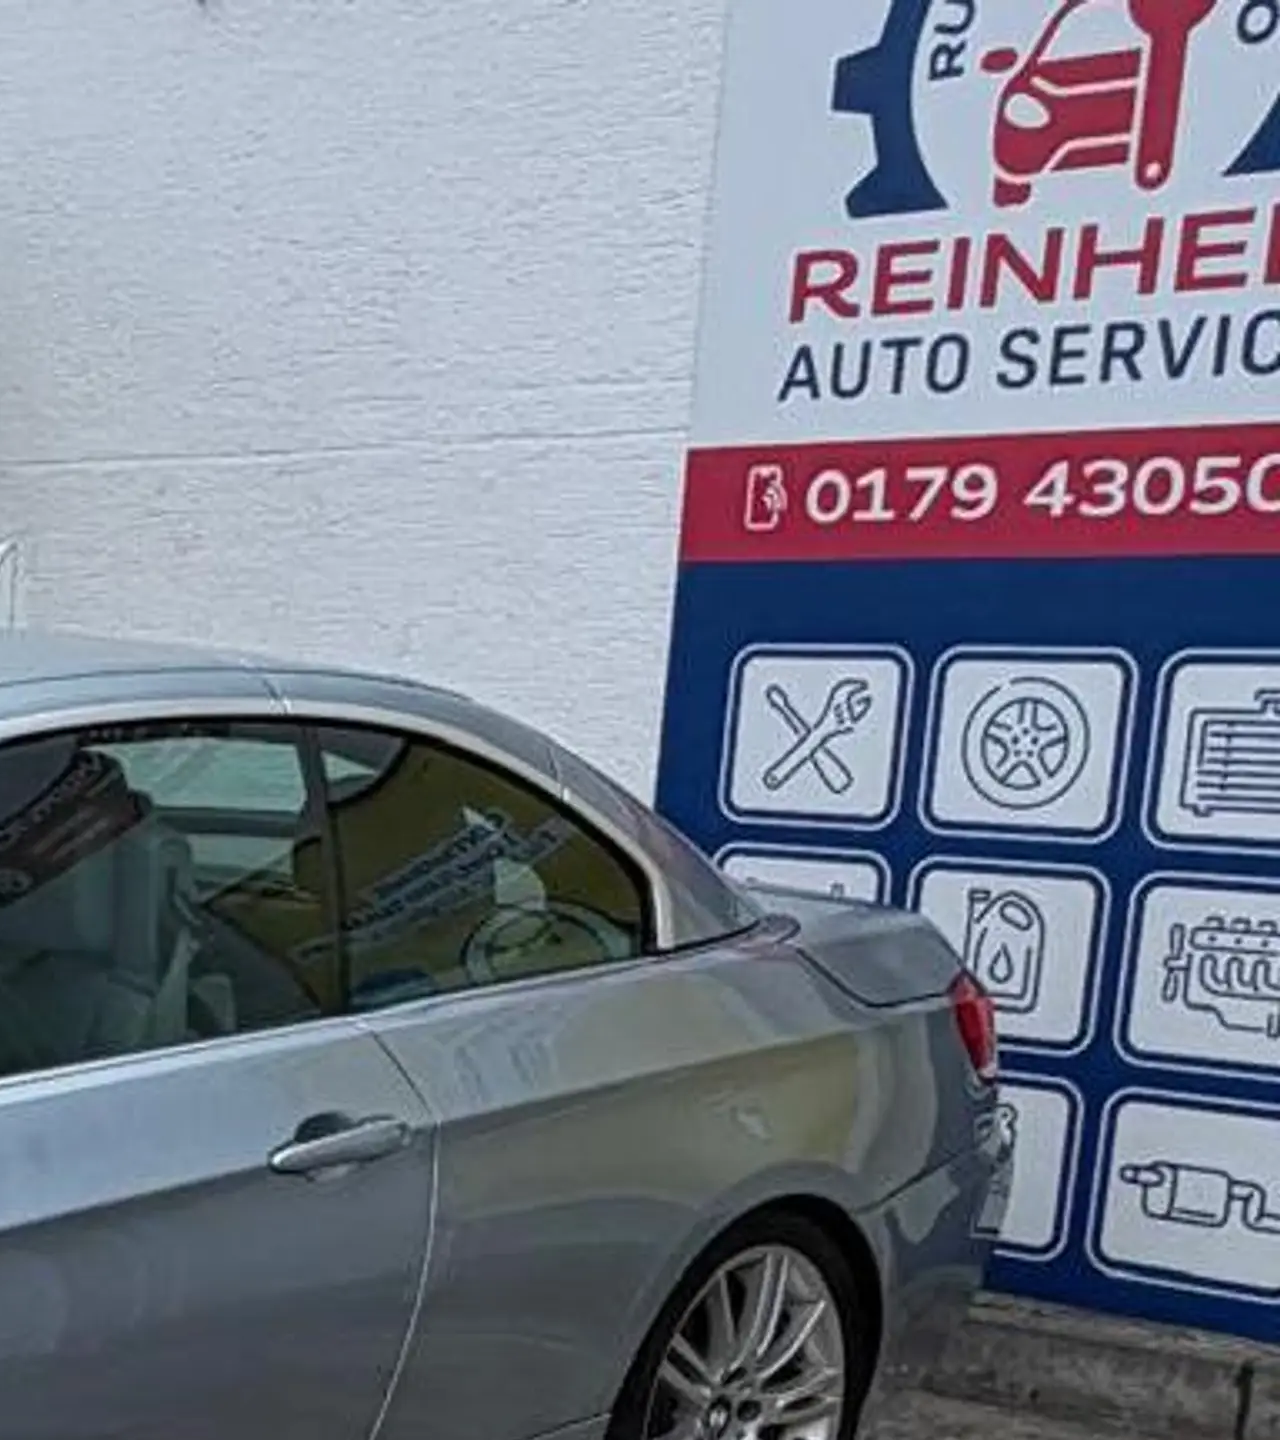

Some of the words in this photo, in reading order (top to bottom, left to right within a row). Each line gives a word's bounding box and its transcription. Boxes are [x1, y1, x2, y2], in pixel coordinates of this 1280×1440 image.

[776, 332, 970, 403] AUTO
[996, 308, 1280, 390] SERVIC
[805, 464, 998, 524] 0179
